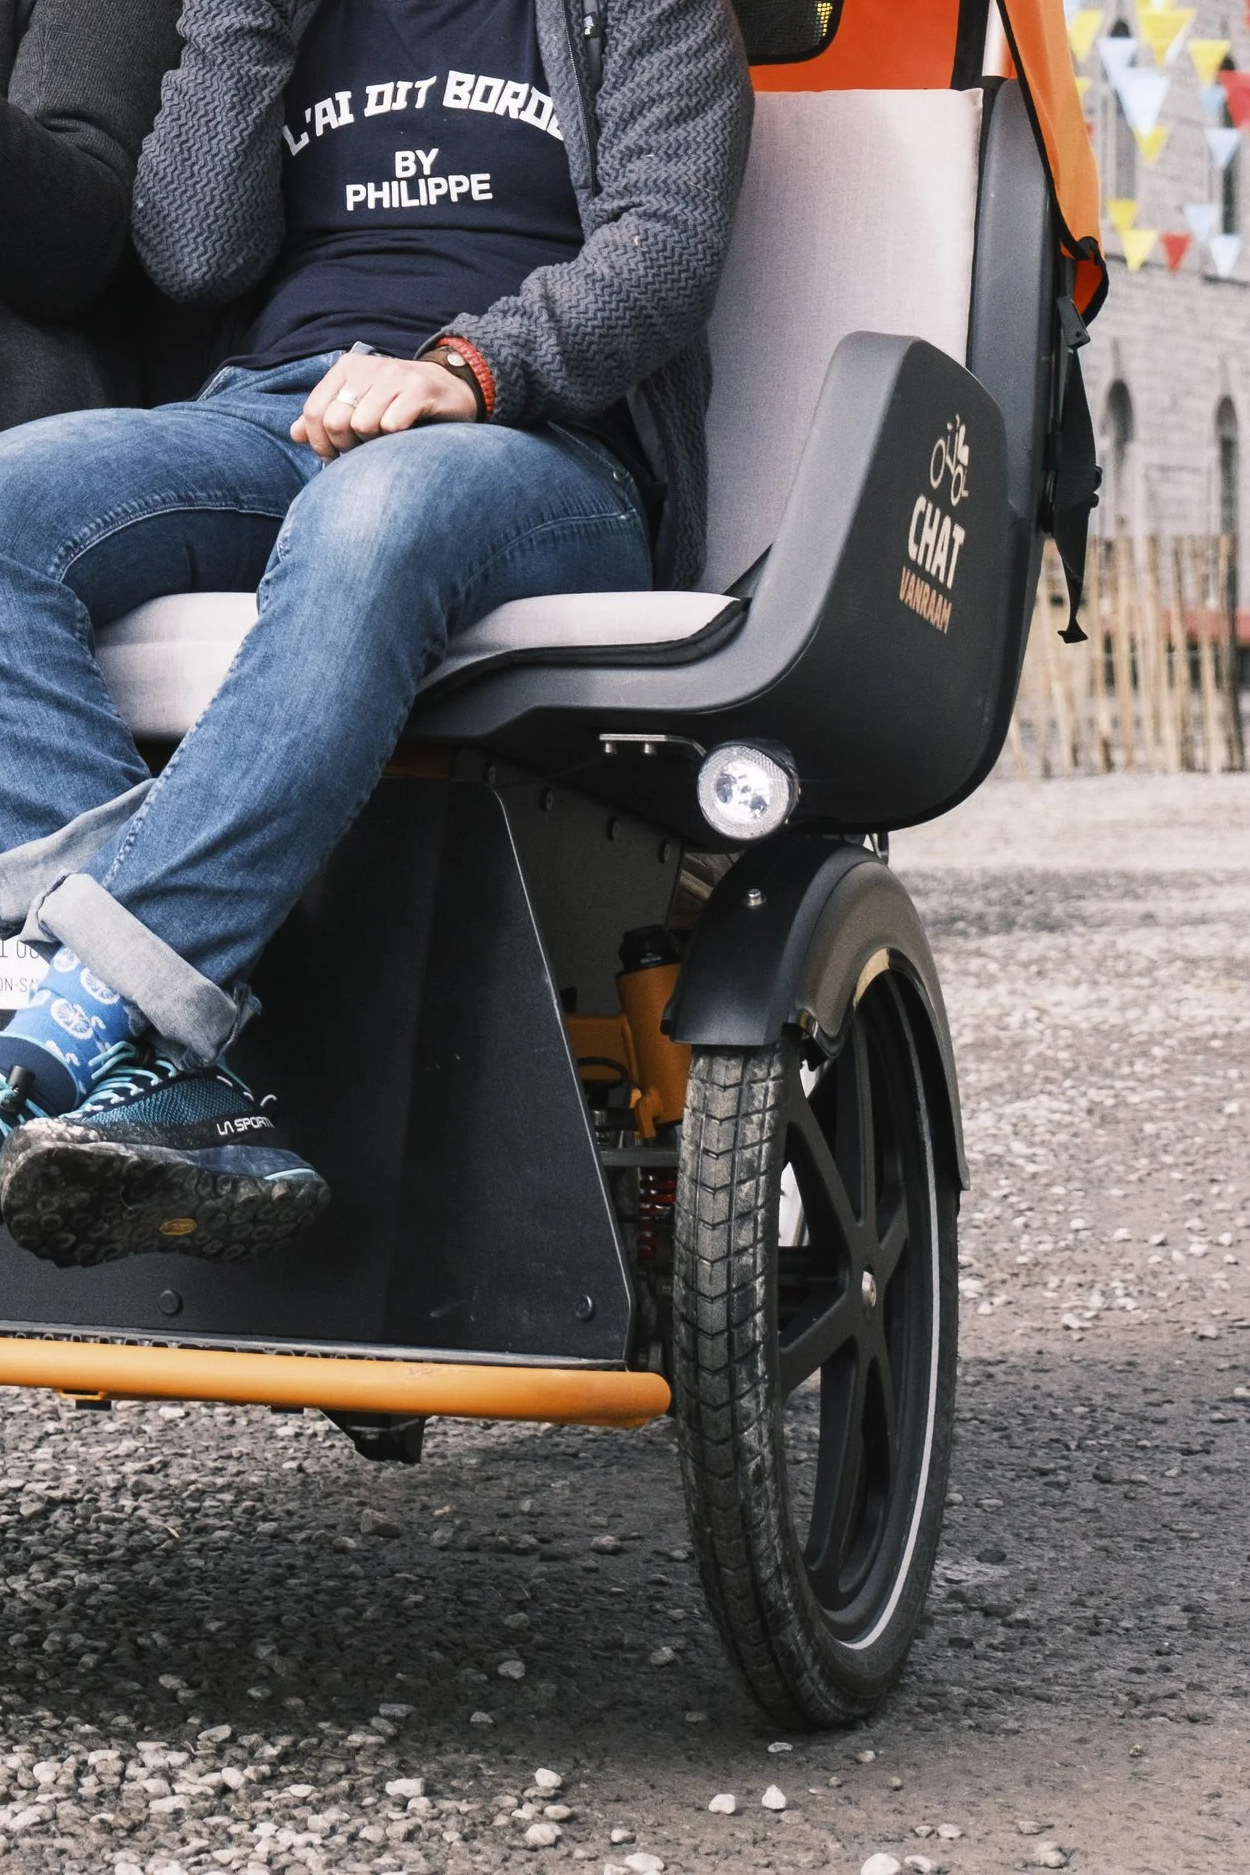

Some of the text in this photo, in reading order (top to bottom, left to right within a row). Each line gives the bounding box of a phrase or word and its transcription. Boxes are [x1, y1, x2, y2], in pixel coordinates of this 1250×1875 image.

[363, 75, 437, 117] DIT
[394, 147, 439, 178] BY
[346, 173, 493, 211] PHILIPPE
[907, 493, 966, 590] CHAT
[216, 1120, 235, 1136] LA
